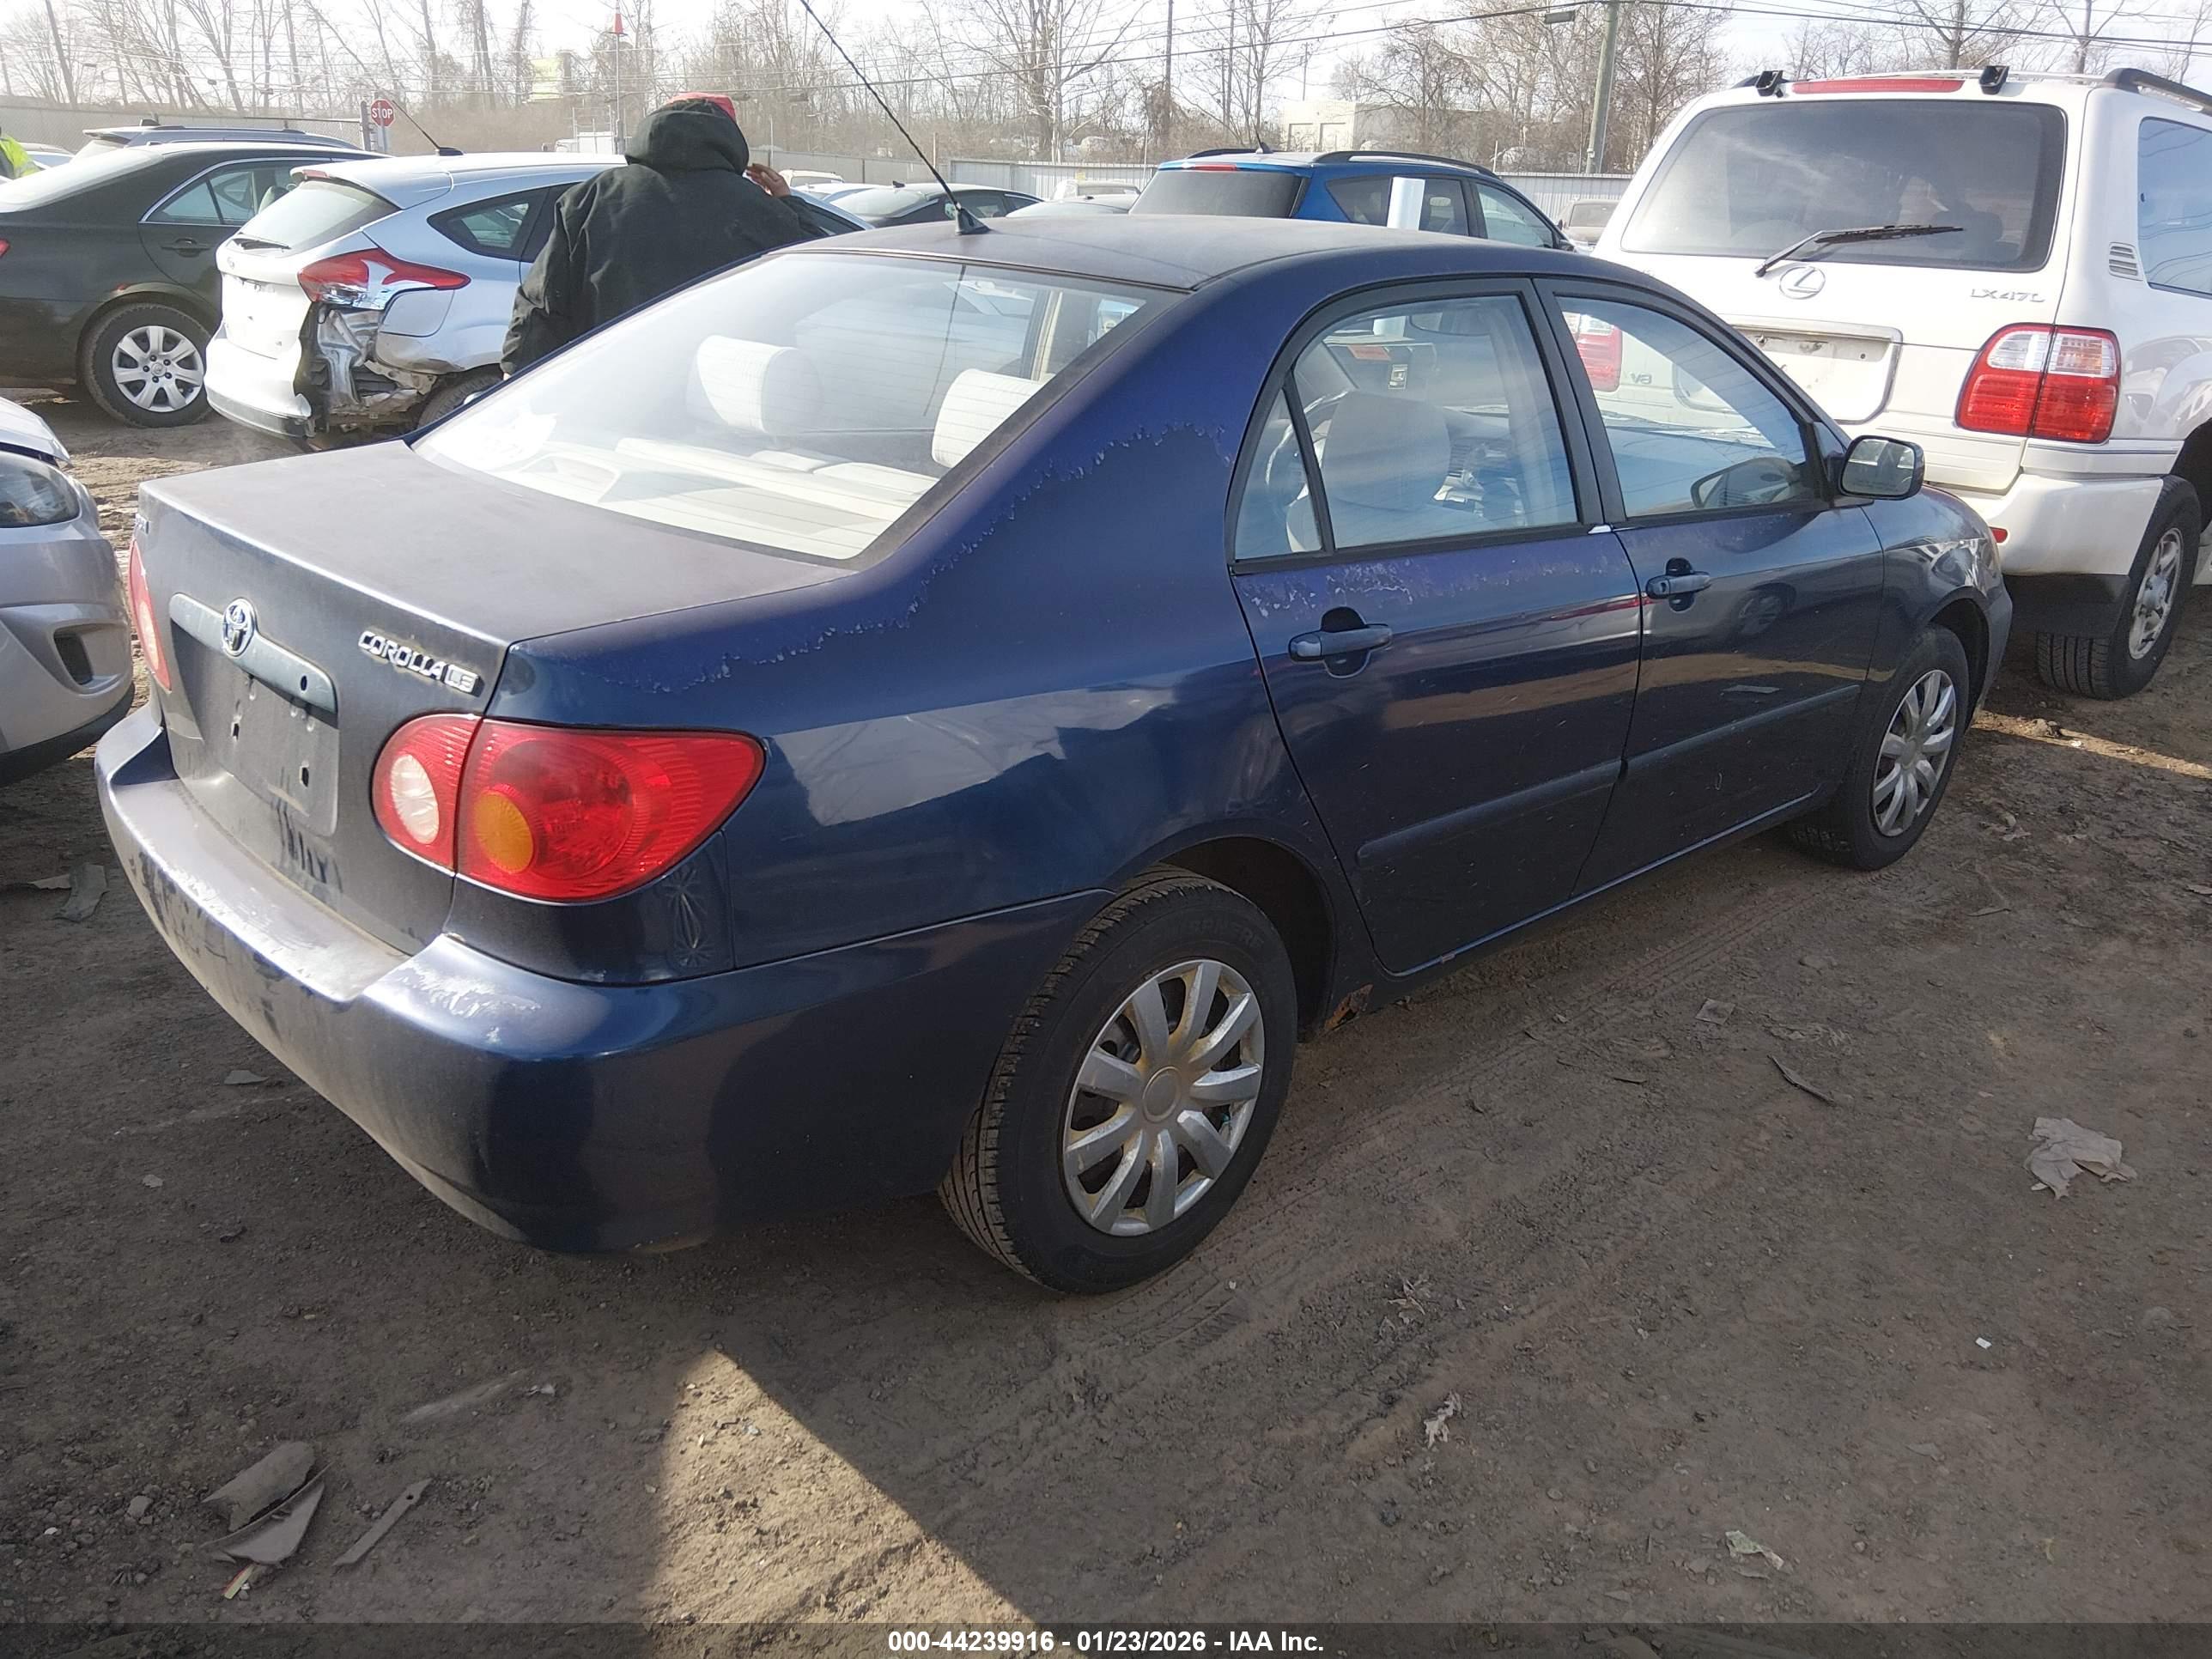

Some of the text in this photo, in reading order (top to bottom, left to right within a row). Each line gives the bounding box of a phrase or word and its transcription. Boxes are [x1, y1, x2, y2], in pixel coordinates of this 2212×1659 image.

[371, 107, 393, 118] STOP
[358, 630, 477, 692] COROLLA LE
